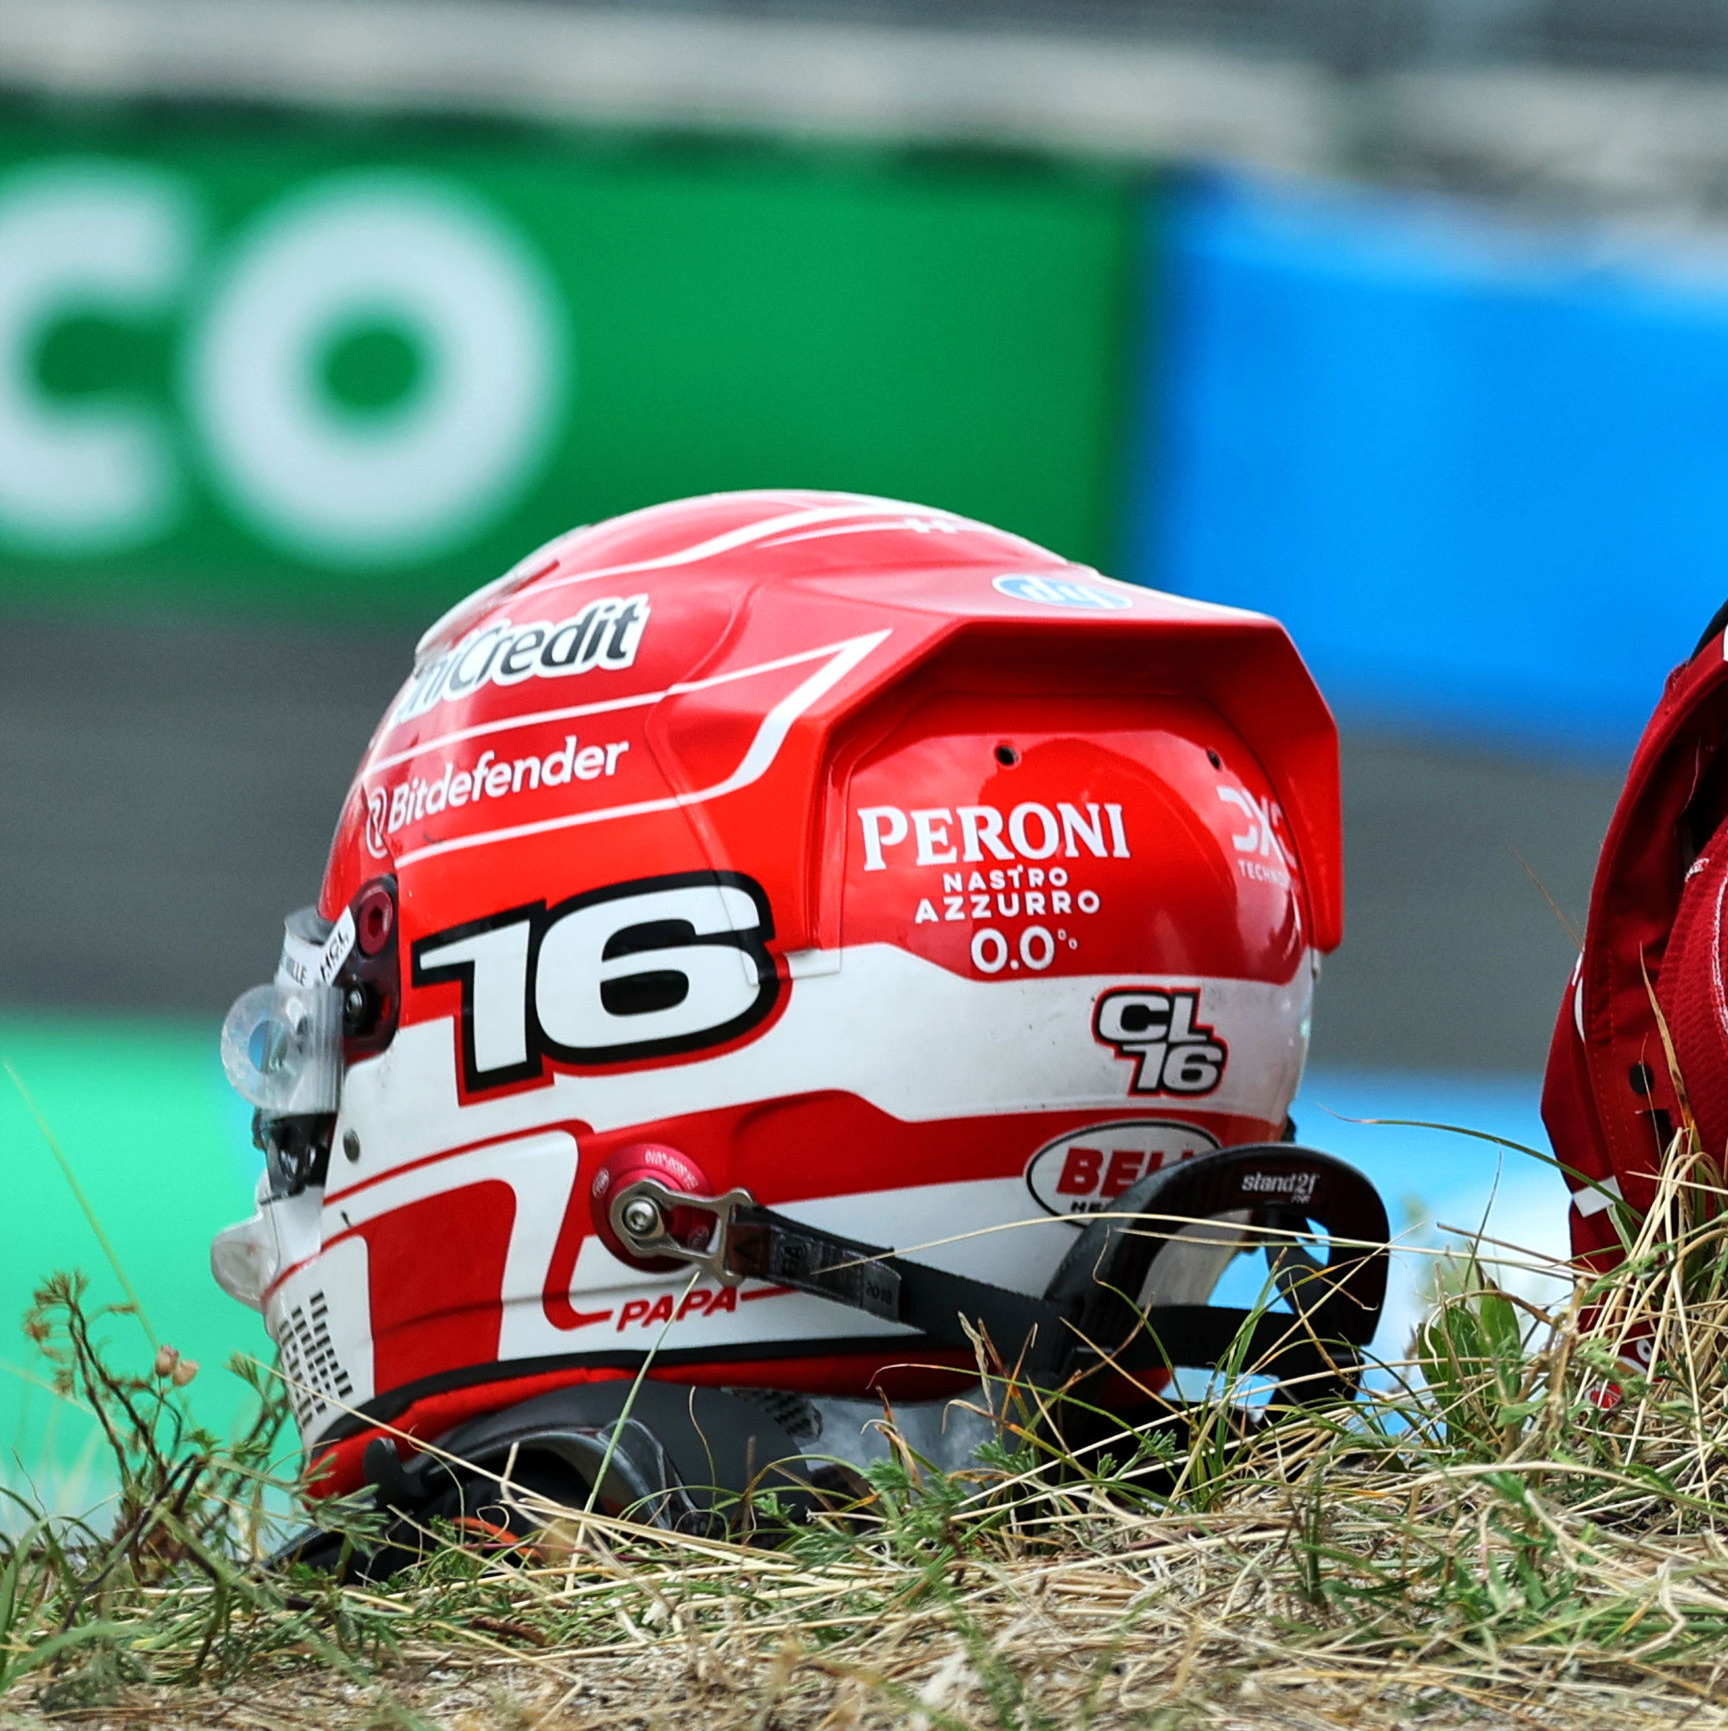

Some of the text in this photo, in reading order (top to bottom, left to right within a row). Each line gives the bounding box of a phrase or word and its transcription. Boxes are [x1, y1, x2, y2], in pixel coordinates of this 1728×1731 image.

[387, 734, 630, 835] Bitdefender
[856, 801, 1132, 872] PERONI
[942, 864, 1069, 893] NASTRO
[914, 890, 1101, 925] AZZURRO
[419, 884, 761, 1074] 16
[1098, 992, 1208, 1044] CL
[1122, 1042, 1224, 1092] 16
[615, 1285, 738, 1333] PAPA
